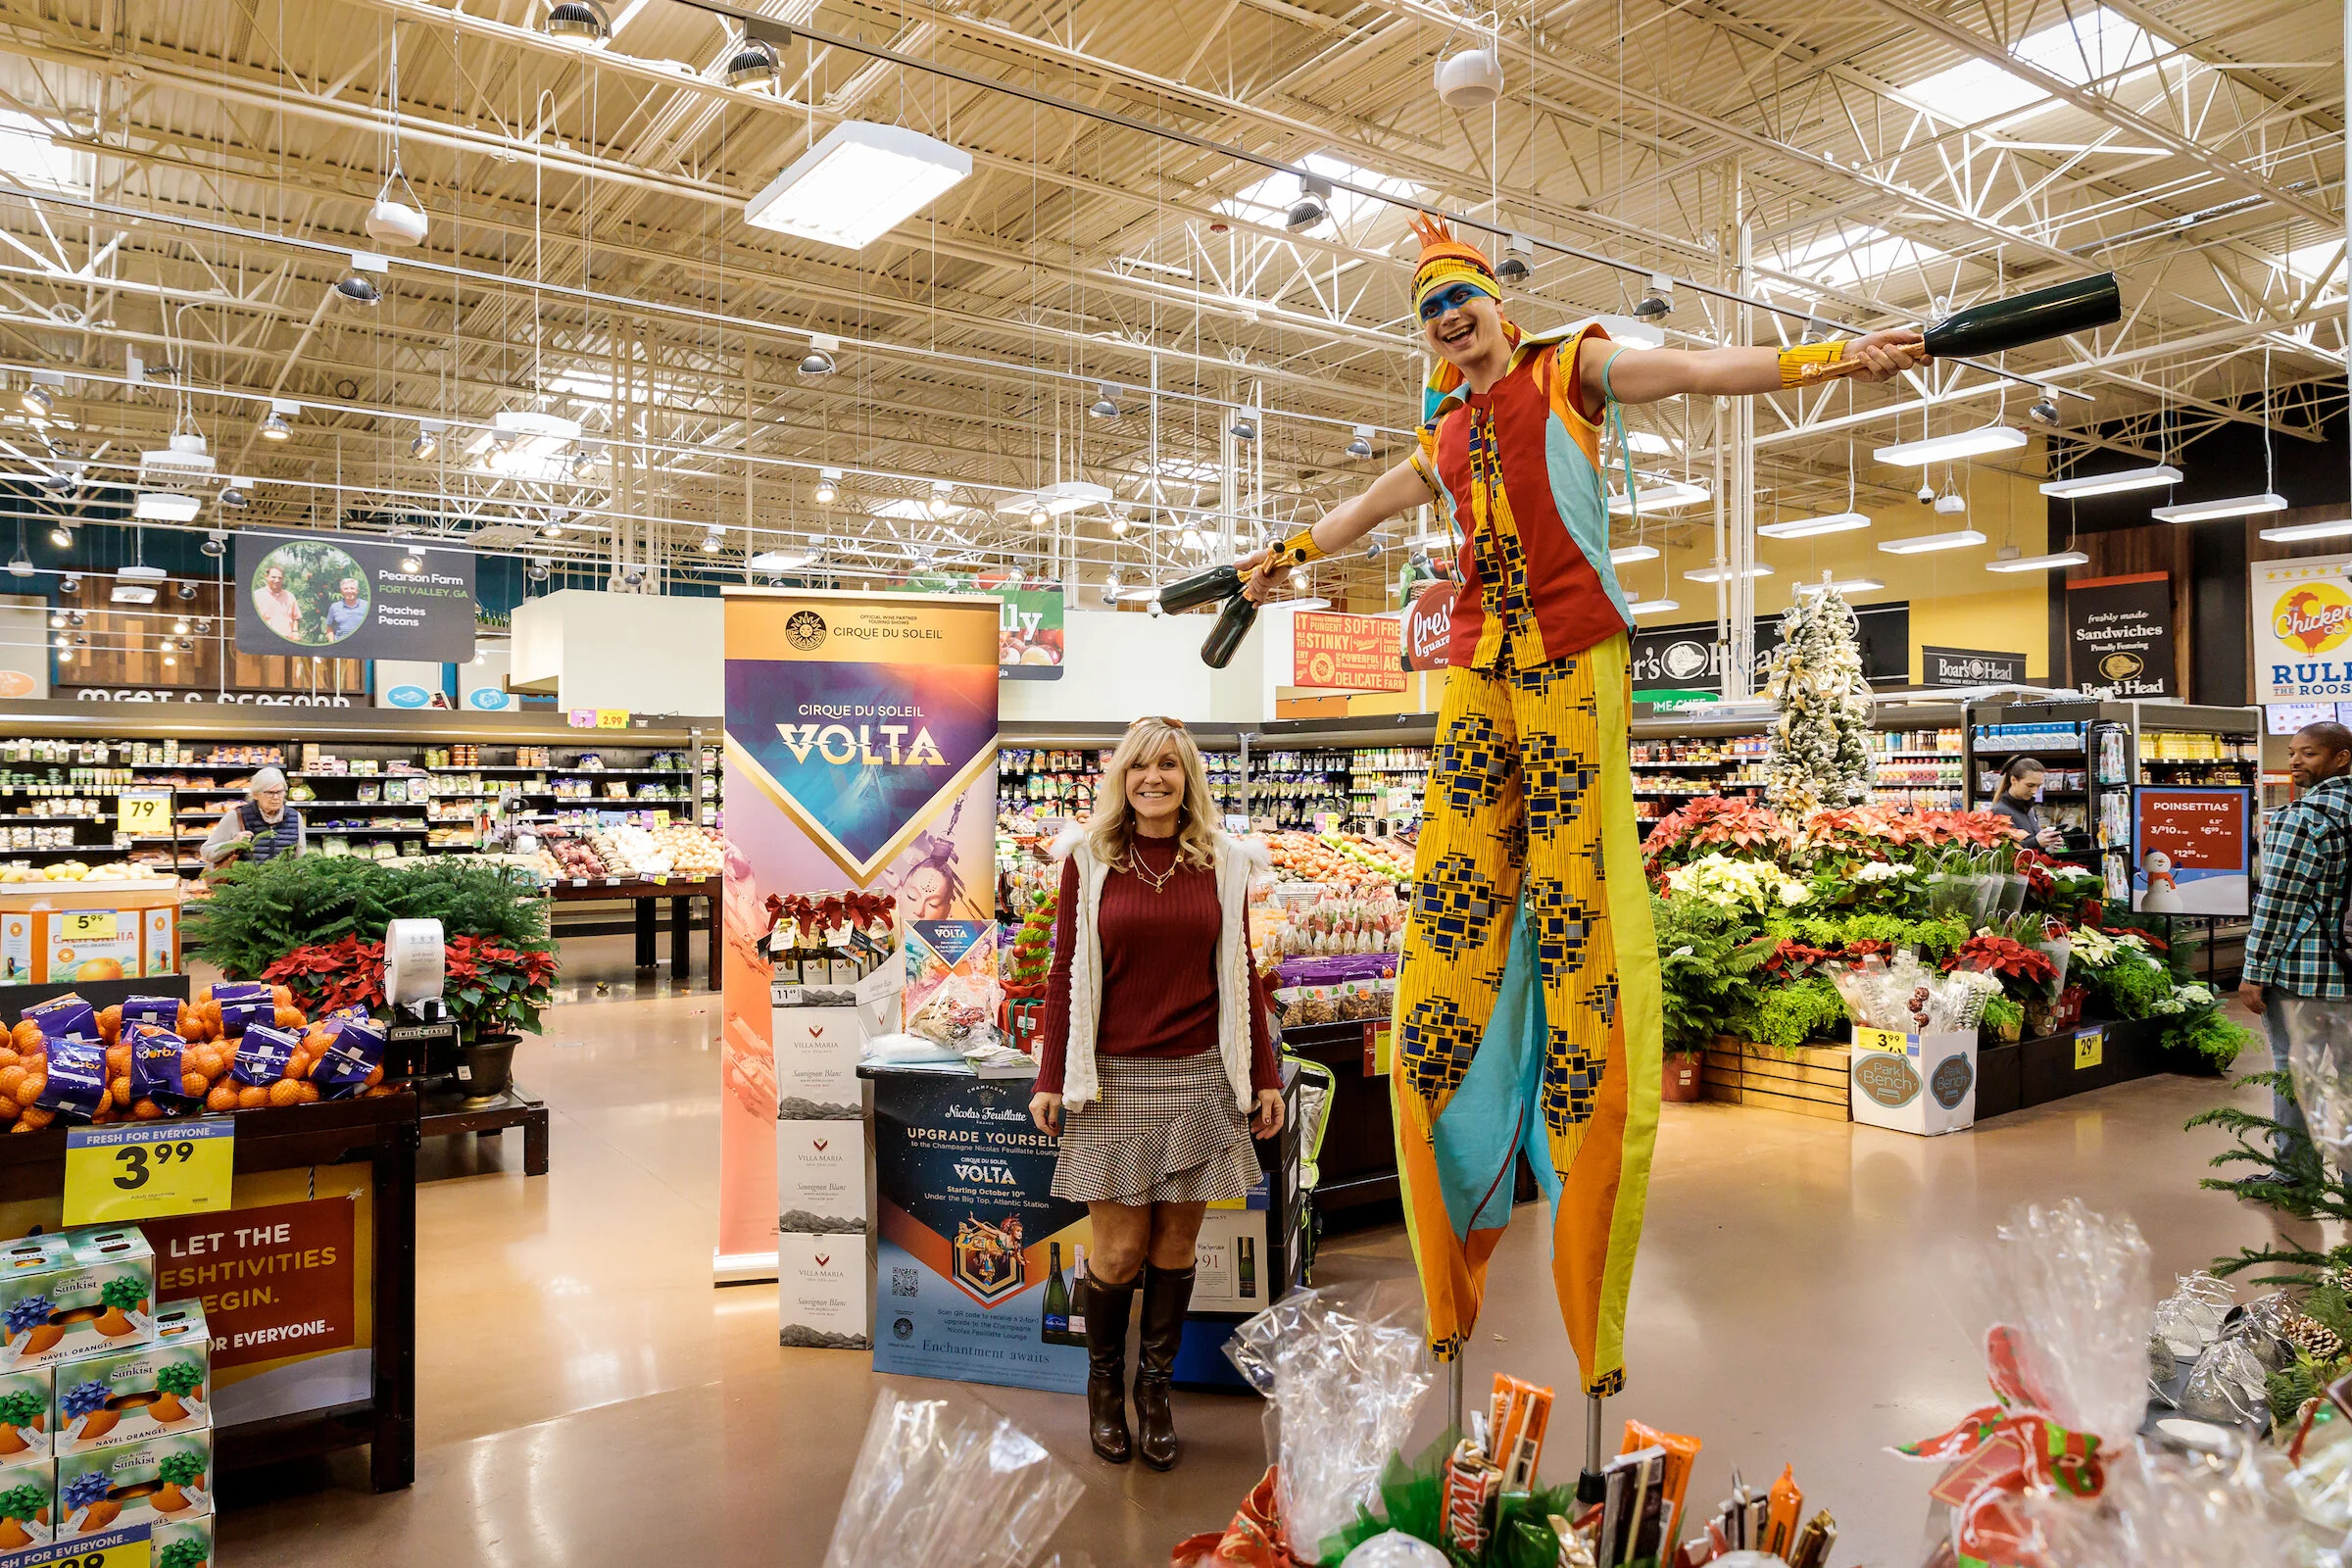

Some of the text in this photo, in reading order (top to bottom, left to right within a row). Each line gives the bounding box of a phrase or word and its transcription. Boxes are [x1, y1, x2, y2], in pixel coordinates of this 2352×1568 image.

[378, 569, 464, 585] Pearson Farm
[378, 585, 408, 594] FORT
[452, 589, 468, 598] GA
[378, 605, 426, 615] Peaches
[2087, 611, 2149, 623] freshly made
[378, 615, 419, 626] Pecans
[1310, 622, 1342, 632] PUNGENT
[1345, 617, 1377, 635] SOFT
[2274, 604, 2352, 639] Chicken
[833, 627, 943, 640] CIRQUE DU SOLEIL
[2077, 624, 2163, 641] Sandwiches
[1306, 632, 1349, 651] STINKY
[2090, 641, 2149, 652] Proudly Featuring
[1342, 653, 1380, 664] POWERFUL
[1938, 659, 2013, 681] Boar's Head
[1335, 671, 1382, 688] DELICATE
[1384, 679, 1405, 690] FARM
[2124, 678, 2164, 695] Head
[2299, 683, 2351, 696] ROOS
[799, 704, 924, 719] CIRQUE DU SOLEIL
[603, 715, 622, 725] 2.99
[775, 723, 947, 766] VOLTA
[2153, 802, 2230, 811] POINSETTIAS
[934, 928, 968, 939] VOLTA
[793, 1069, 823, 1078] Sauvignon
[1874, 1062, 1900, 1076] Park
[1864, 1070, 1912, 1091] Bench
[1936, 1075, 1967, 1091] Bench
[966, 1085, 1007, 1096] CHAMPAGNE
[945, 1103, 1027, 1122] Nicolas Feuillatte
[86, 1127, 210, 1145] FRESH FOR EVERYONE
[907, 1127, 979, 1143] UPGRADE
[932, 1142, 972, 1152] Champagne
[1002, 1146, 1033, 1154] Feuillatte
[953, 1164, 1017, 1185] VOLTA
[797, 1183, 827, 1192] Sauvignon
[947, 1186, 977, 1196] Starting
[993, 1198, 1021, 1207] Atlantic
[1023, 1200, 1050, 1209] Station
[171, 1223, 291, 1257] LET THE
[160, 1247, 337, 1290] ESHTIVITIES
[1201, 1253, 1218, 1269] 91
[55, 1281, 98, 1296] Sunkist
[798, 1297, 827, 1306] Sauvignon
[233, 1319, 326, 1348] EVERYONE
[971, 1329, 1002, 1338] Feuillatte
[1003, 1332, 1027, 1341] Lounge
[993, 1323, 1032, 1333] Champagne
[40, 1341, 114, 1362] NAVEL ORANGES
[922, 1340, 1051, 1363] Enchantment awaits
[112, 1366, 154, 1381] Sunkist
[95, 1427, 168, 1447] NAVEL ORANGES
[114, 1456, 156, 1471] Sunkist
[24, 1551, 52, 1565] FOR
[56, 1534, 123, 1557] EVERYONE
